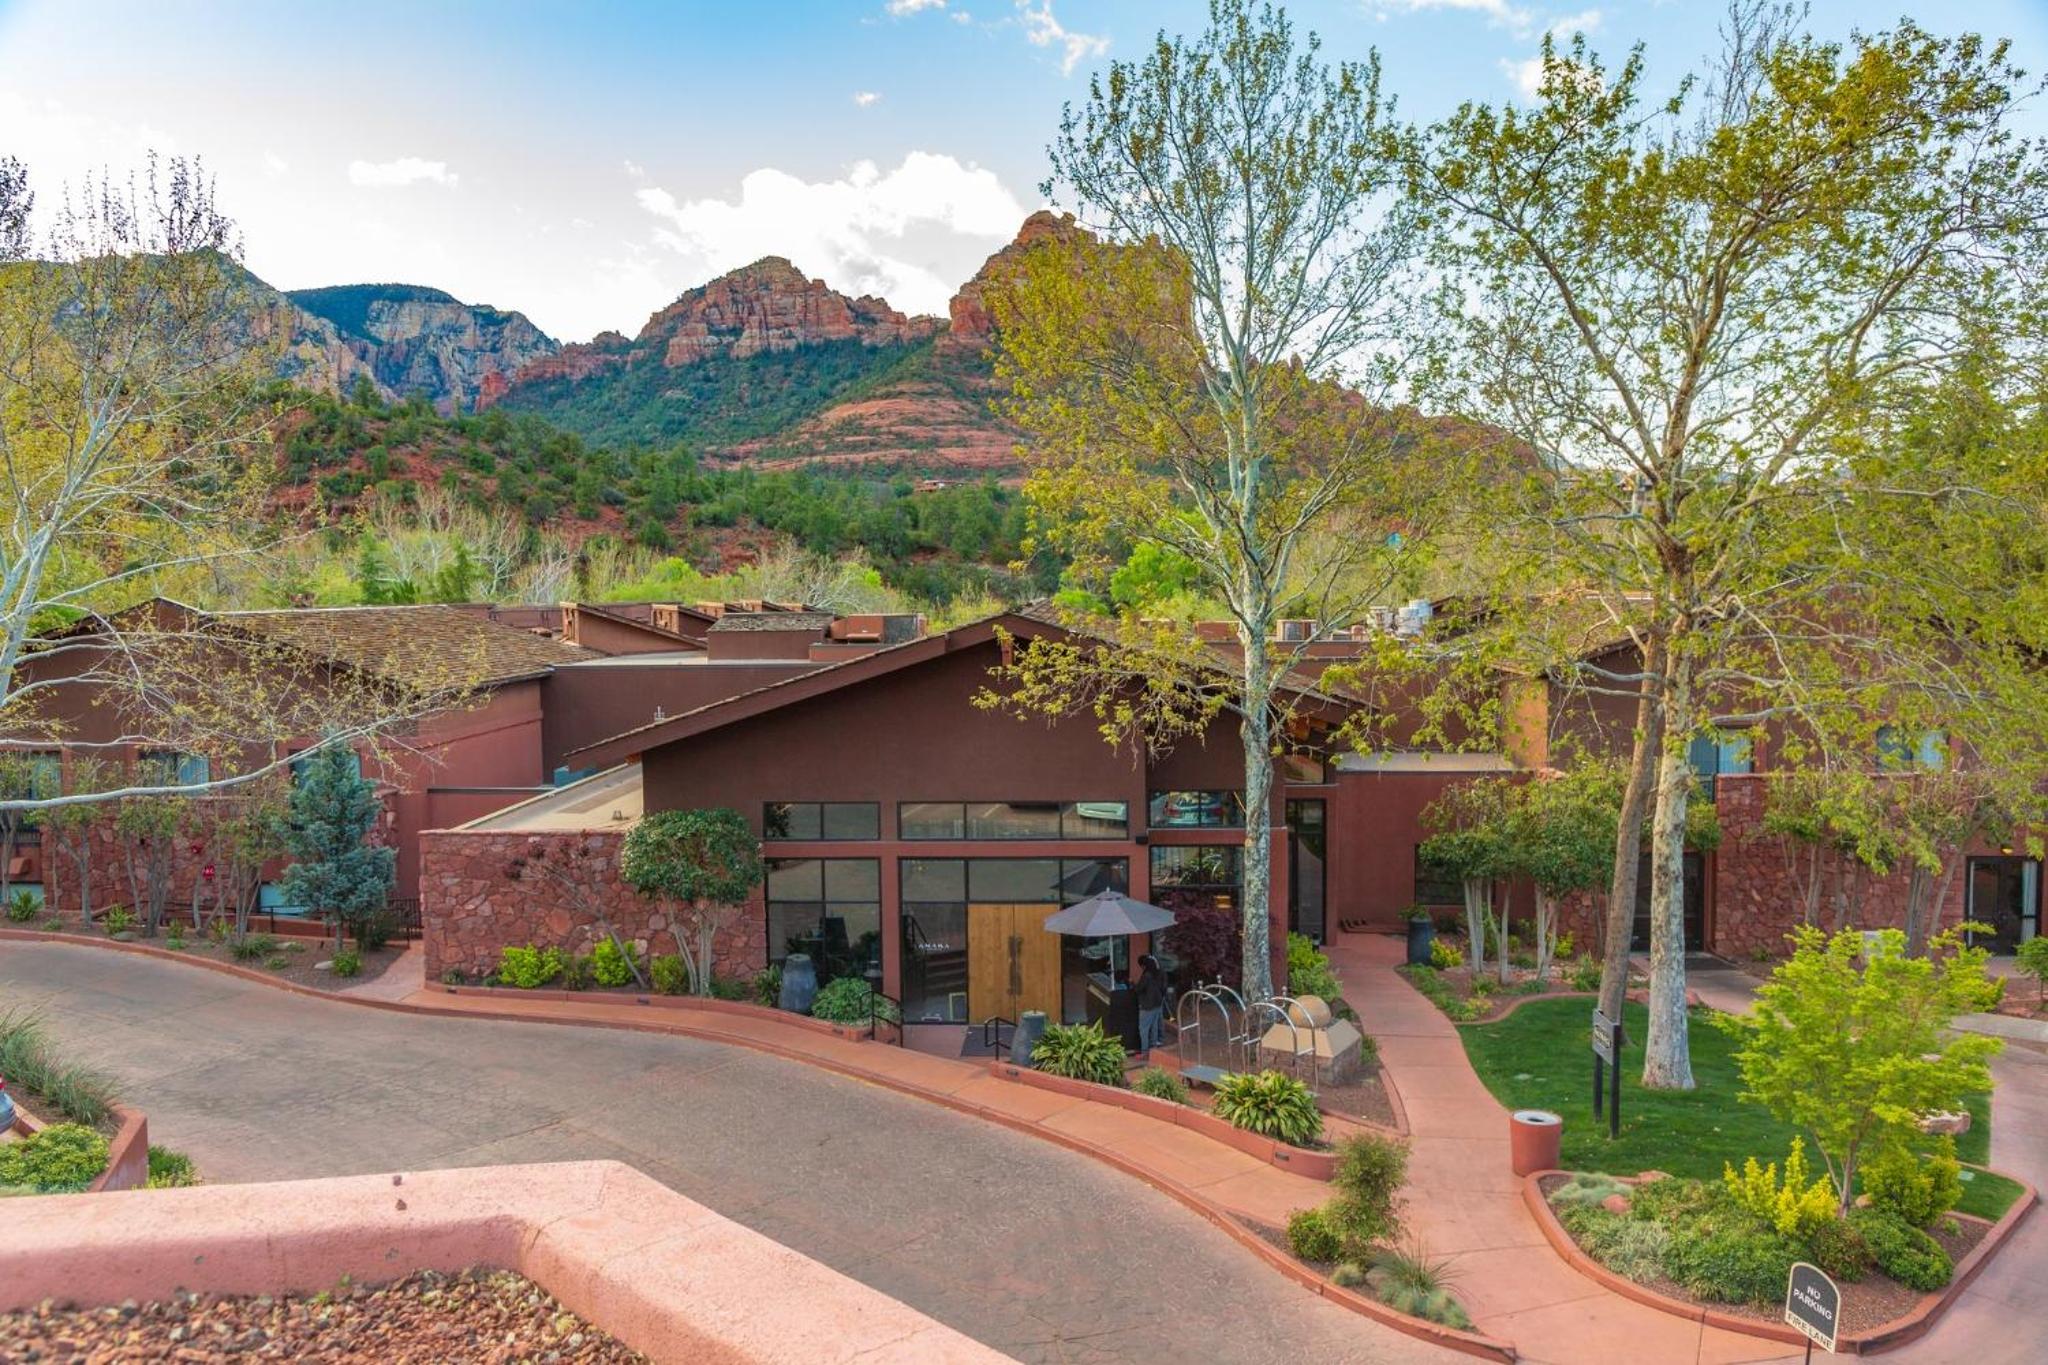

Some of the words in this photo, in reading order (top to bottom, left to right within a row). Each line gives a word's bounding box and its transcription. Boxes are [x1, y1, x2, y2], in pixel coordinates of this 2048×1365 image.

[1793, 1288, 1832, 1320] PARKING
[1807, 1286, 1821, 1300] NO
[1788, 1313, 1808, 1329] FIRE
[1809, 1327, 1833, 1349] LANE
